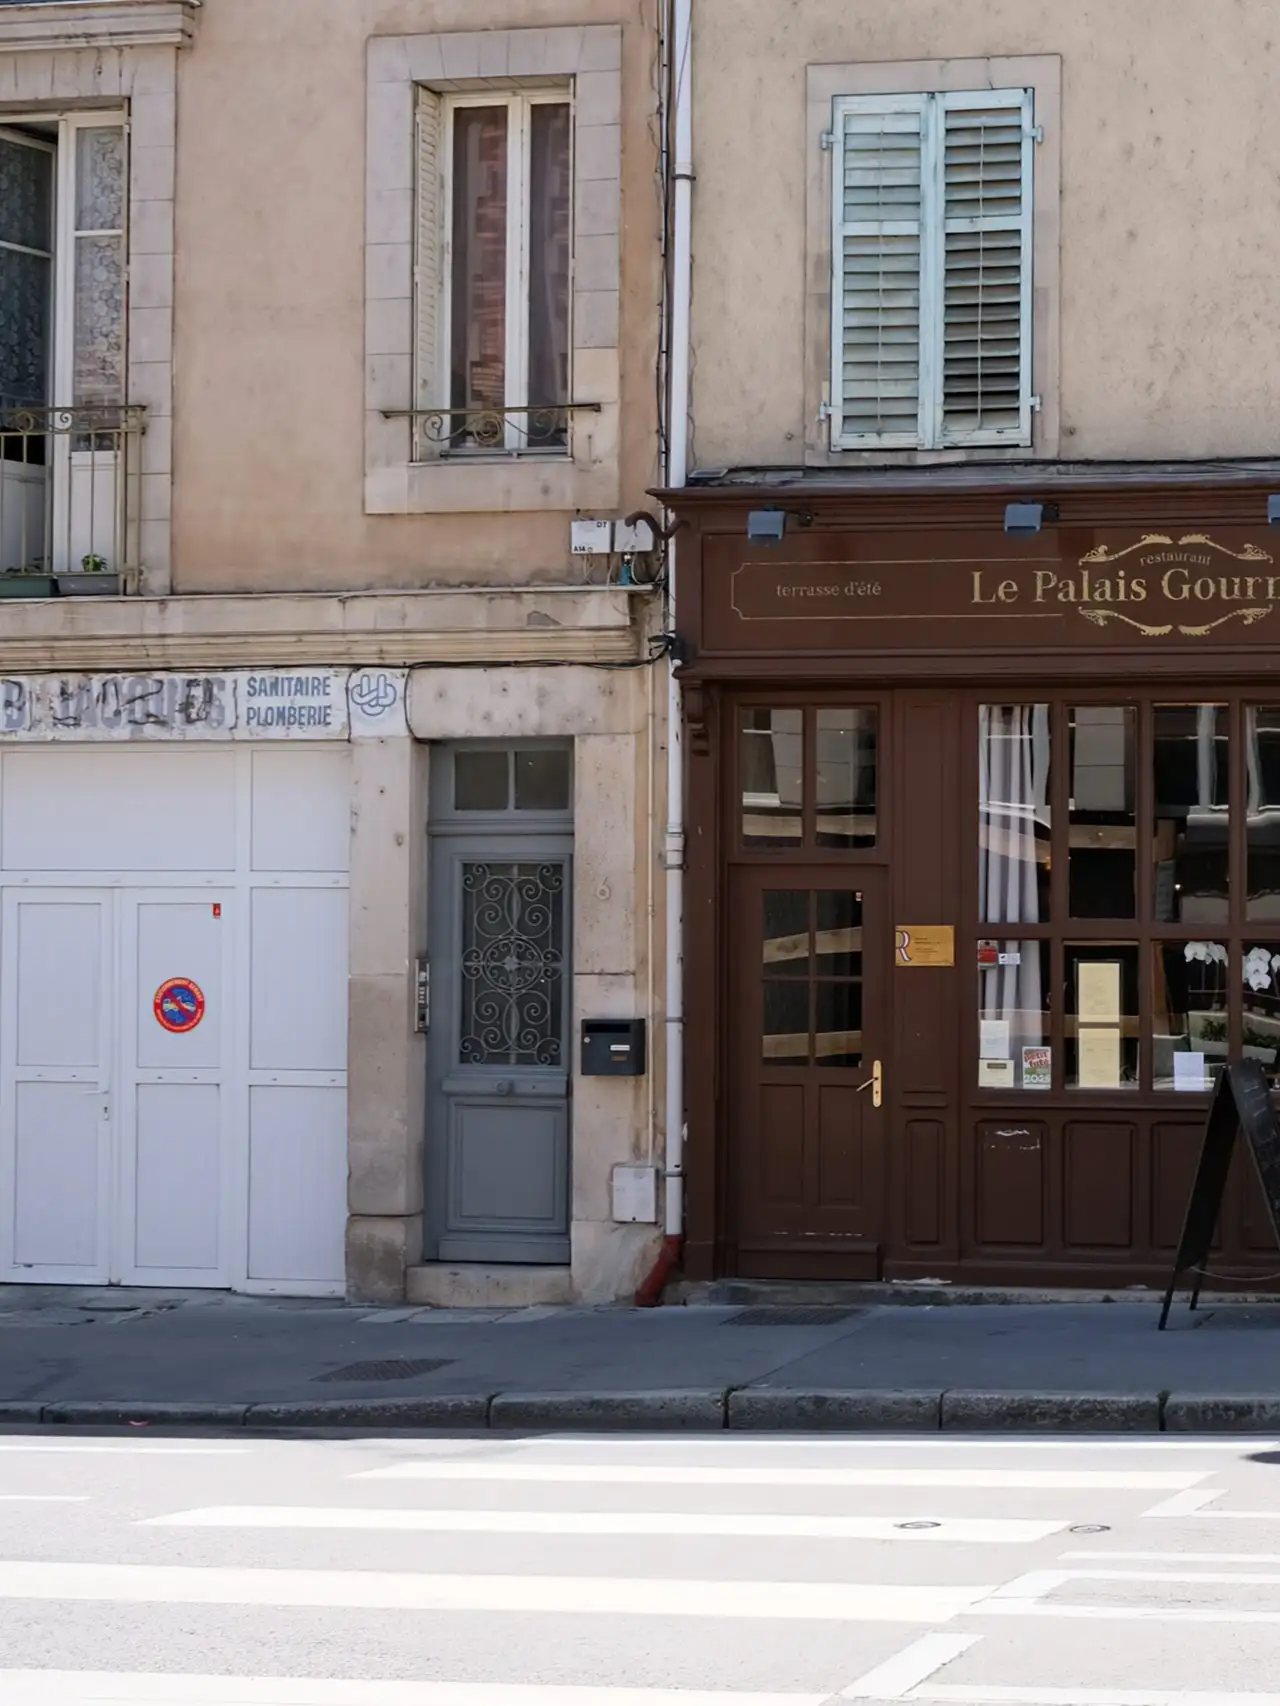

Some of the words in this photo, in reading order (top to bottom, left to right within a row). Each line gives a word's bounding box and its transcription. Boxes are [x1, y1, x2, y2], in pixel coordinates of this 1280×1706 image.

[1139, 550, 1213, 567] restaurant
[776, 583, 840, 598] terrasse
[971, 570, 1020, 604] Le
[1032, 569, 1148, 604] Palais
[246, 676, 331, 698] SANITAIRE
[246, 704, 332, 727] PLOMBERIE
[596, 872, 612, 901] 6
